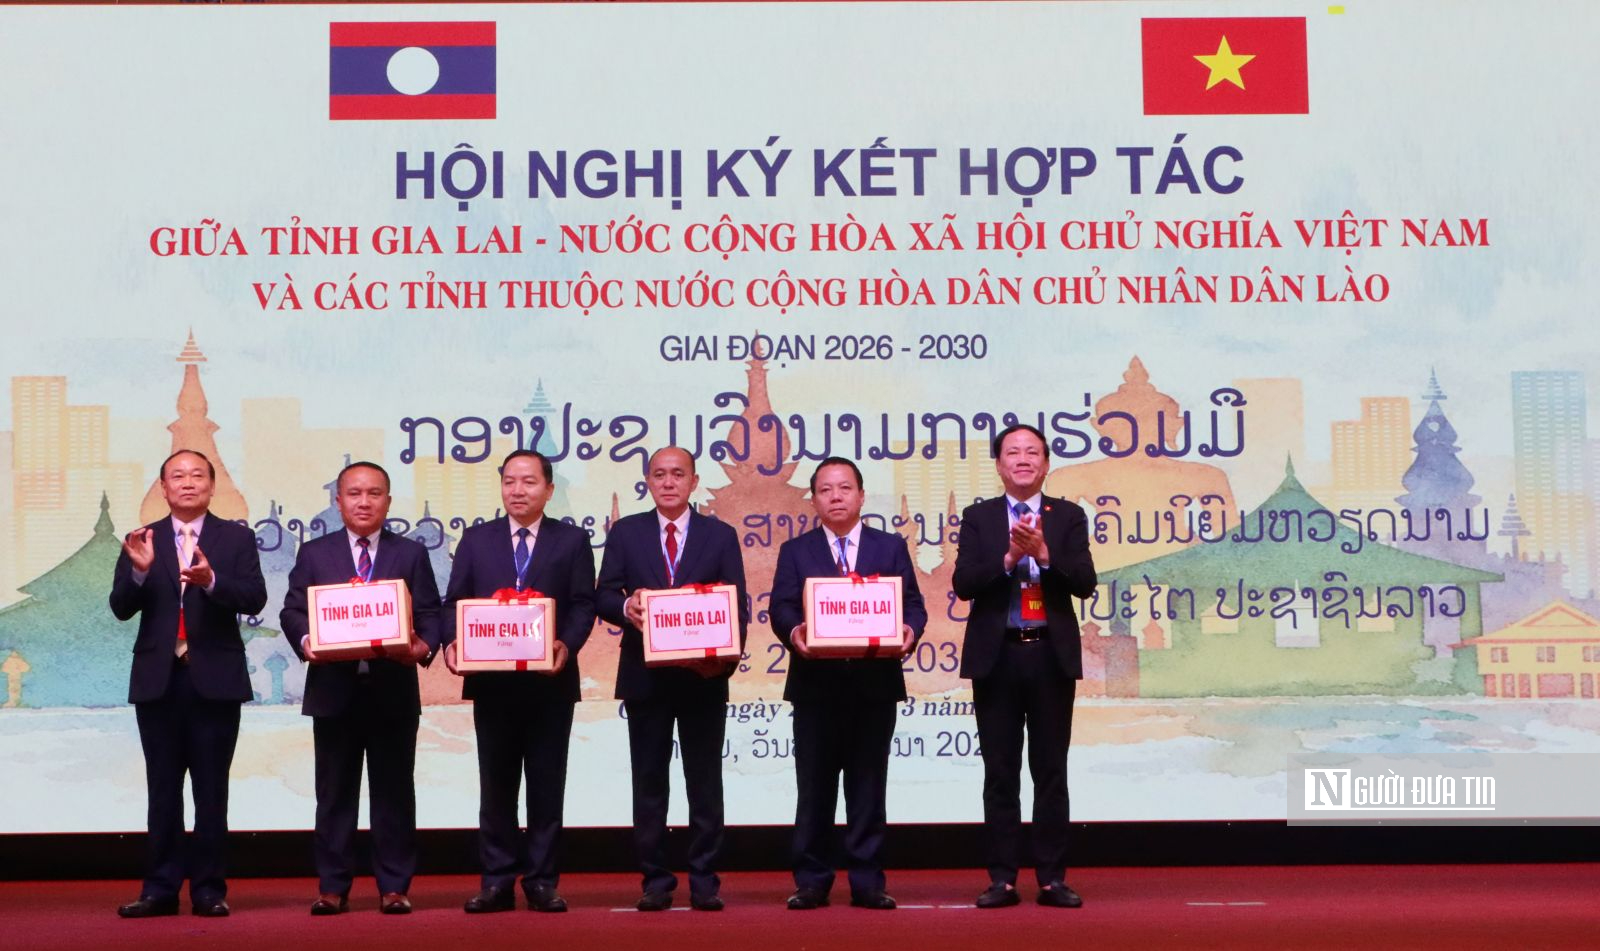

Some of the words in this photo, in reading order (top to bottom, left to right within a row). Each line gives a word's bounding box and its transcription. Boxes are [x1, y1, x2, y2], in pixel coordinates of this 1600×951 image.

[396, 142, 504, 212] HỘI
[528, 149, 682, 210] NGHỊ
[707, 135, 792, 198] KÝ
[813, 136, 937, 197] KẾT
[959, 147, 1097, 208] HỢP
[1116, 133, 1244, 195] TÁC
[149, 218, 248, 257] GIỮA
[262, 215, 358, 256] TỈNH
[371, 225, 442, 255] GIA
[456, 225, 522, 255] LAI
[559, 214, 671, 254] NƯỚC
[684, 213, 796, 261] CỘNG
[811, 213, 897, 253] HÒA
[911, 213, 964, 251] XÃ
[977, 212, 1046, 258] HỘI
[1060, 211, 1142, 251] CHỦ
[1155, 211, 1281, 249] NGHĨA
[1295, 210, 1388, 256] VIỆT
[1402, 218, 1489, 247] NAM
[252, 273, 302, 311] VÀ
[313, 272, 388, 311] CÁC
[400, 272, 487, 309] TỈNH
[499, 271, 624, 315] THUỘC
[636, 271, 735, 308] NƯỚC
[746, 269, 847, 315] CỘNG
[859, 268, 936, 306] HÒA
[947, 267, 1022, 305] DÂN
[1033, 266, 1106, 305] CHỦ
[1119, 267, 1218, 304] NHÂN
[1230, 265, 1303, 303] DÂN
[1316, 265, 1390, 303] LÀO
[659, 335, 718, 362] GIAI
[726, 335, 815, 368] ĐOẠN
[824, 334, 893, 361] 2026
[919, 334, 988, 360] 2030
[321, 602, 349, 622] TỈNH
[352, 604, 372, 619] GIA
[376, 602, 394, 617] LAI
[654, 609, 681, 628] TỈNH
[684, 611, 705, 626] GIA
[707, 610, 726, 625] LAI
[818, 596, 846, 615] TỈNH
[850, 600, 870, 615] GIA
[873, 600, 891, 614] LAI
[468, 618, 495, 638] TỈNH
